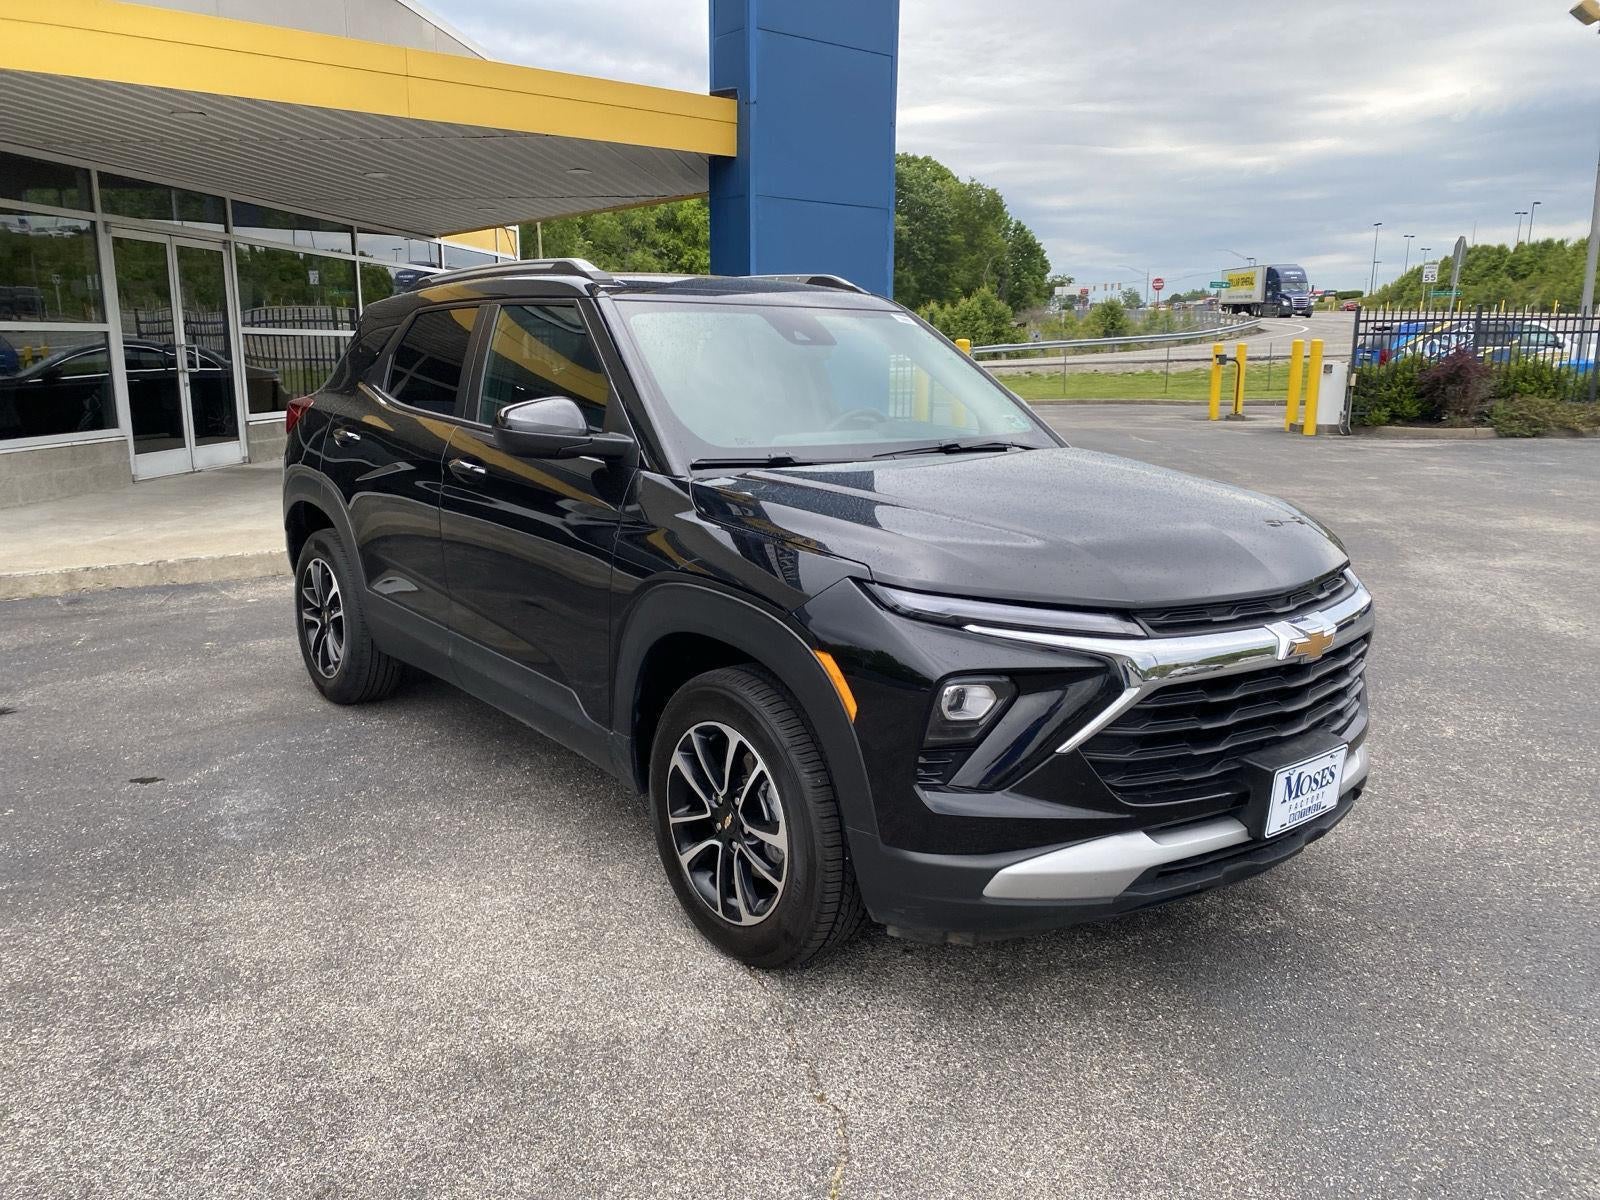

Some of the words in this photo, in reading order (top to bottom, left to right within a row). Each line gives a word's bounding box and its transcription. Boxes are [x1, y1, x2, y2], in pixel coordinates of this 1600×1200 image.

[1424, 274, 1437, 282] 55
[1281, 764, 1337, 804] MOSES
[1288, 791, 1325, 813] FACTORY
